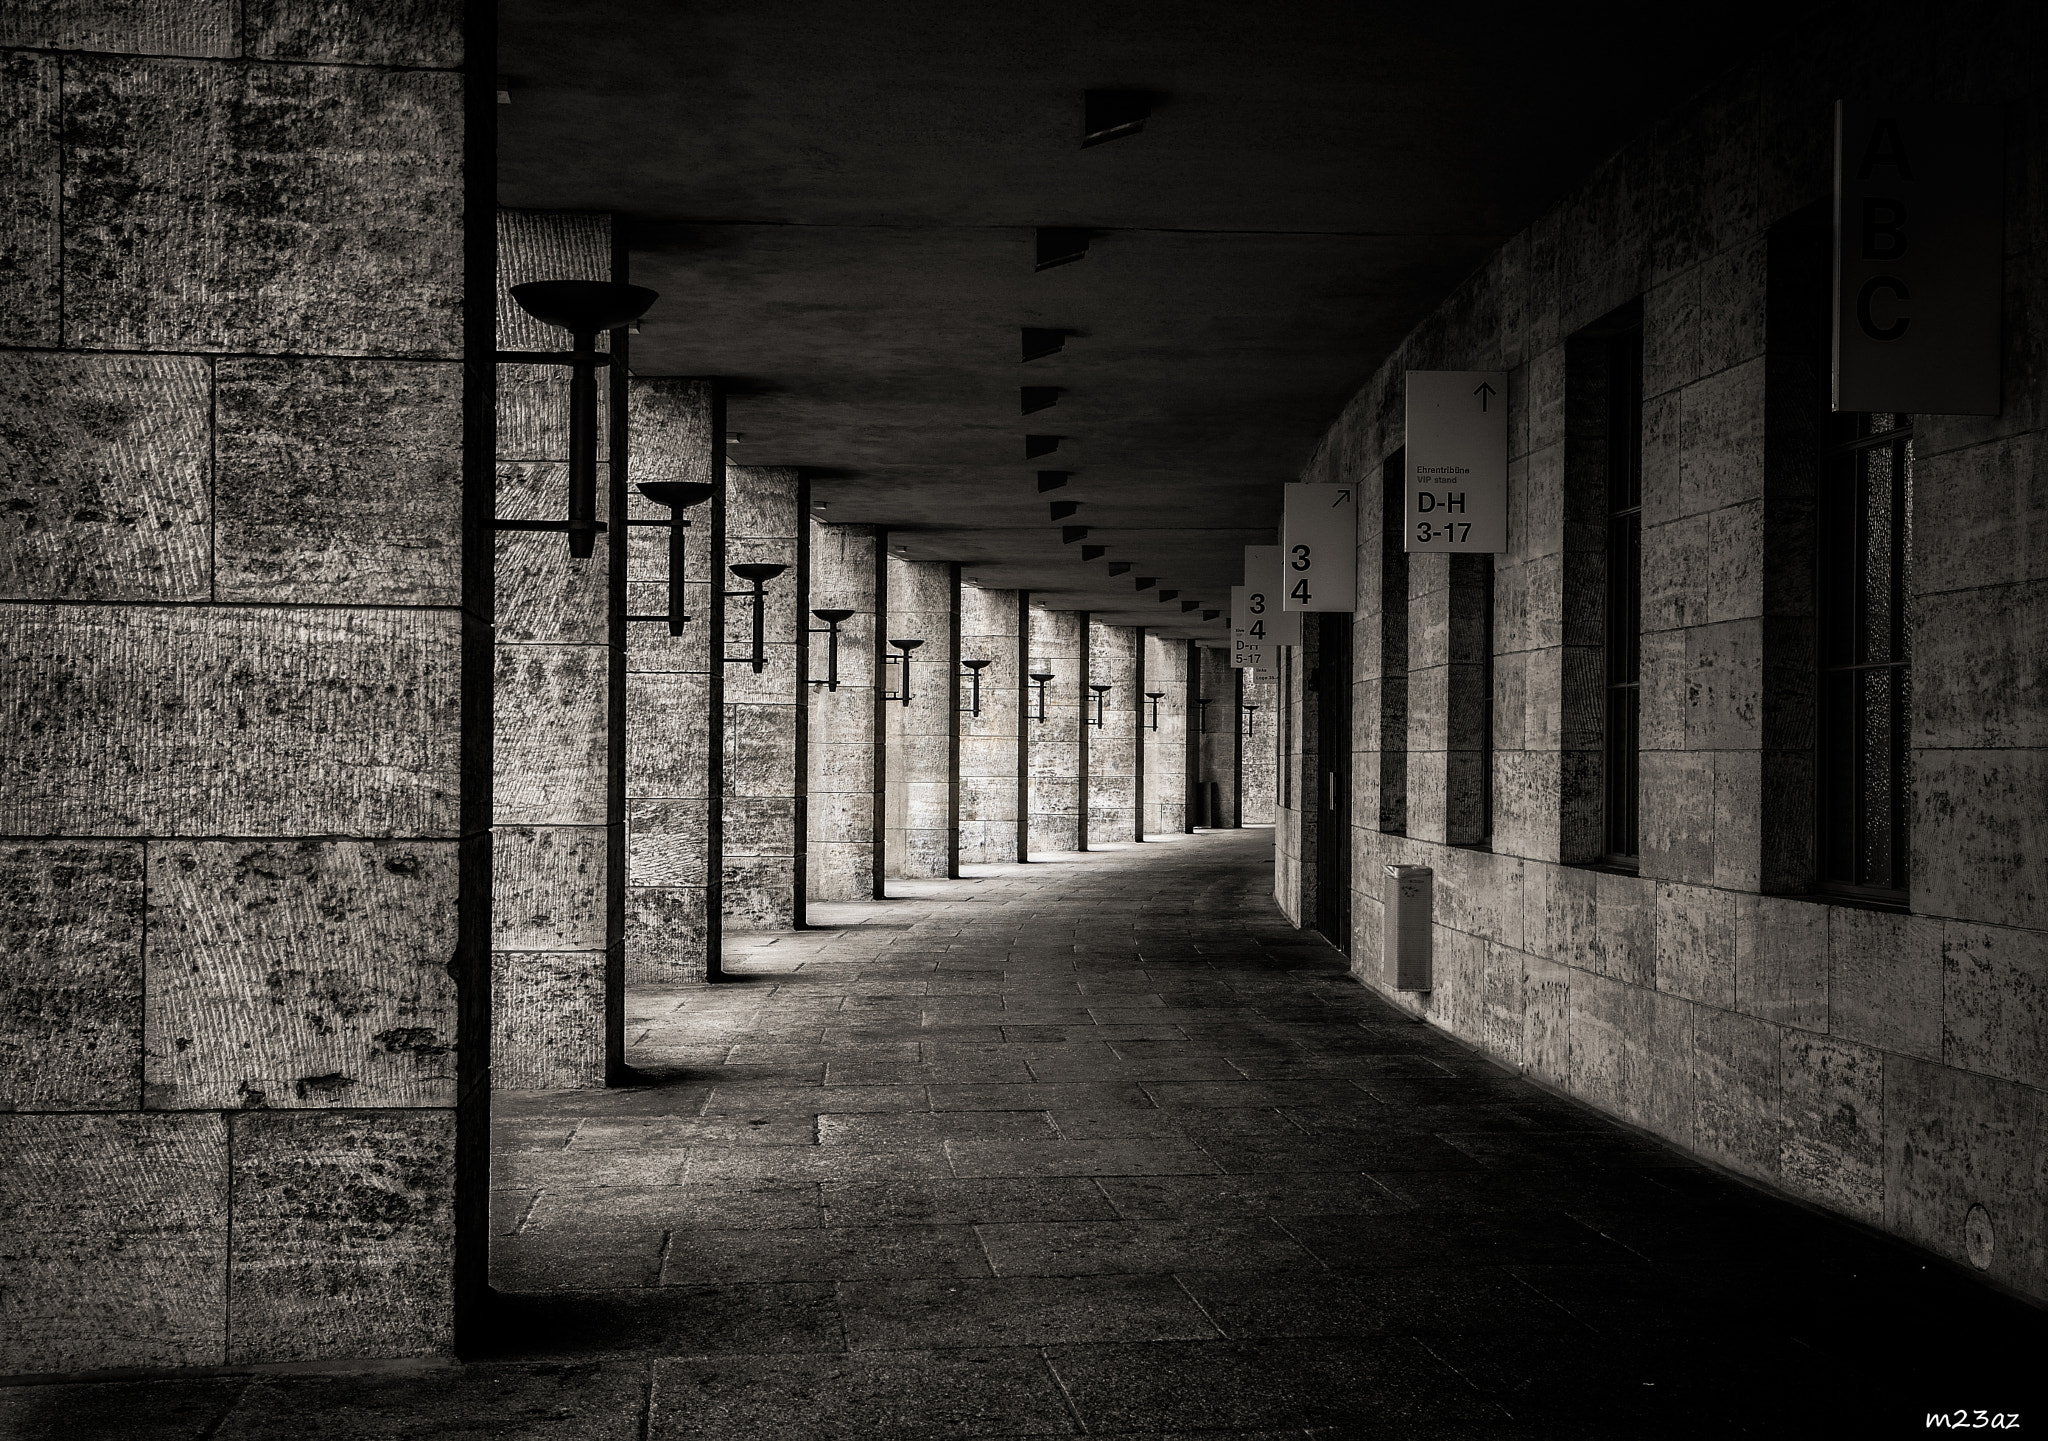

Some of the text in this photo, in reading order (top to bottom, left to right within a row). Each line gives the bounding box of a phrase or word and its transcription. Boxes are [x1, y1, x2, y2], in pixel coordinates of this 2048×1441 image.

[1856, 117, 1914, 182] A
[1861, 196, 1908, 261] B
[1856, 275, 1912, 342] C
[1416, 465, 1470, 474] Ehrentribüne
[1416, 475, 1457, 484] VIP stand
[1417, 491, 1466, 514] D-H
[1416, 521, 1472, 543] 3-17
[1291, 544, 1311, 572] 3
[1290, 578, 1312, 605] 4
[1249, 593, 1265, 615] 3
[1249, 619, 1266, 640] 4
[1235, 653, 1261, 664] 5-17
